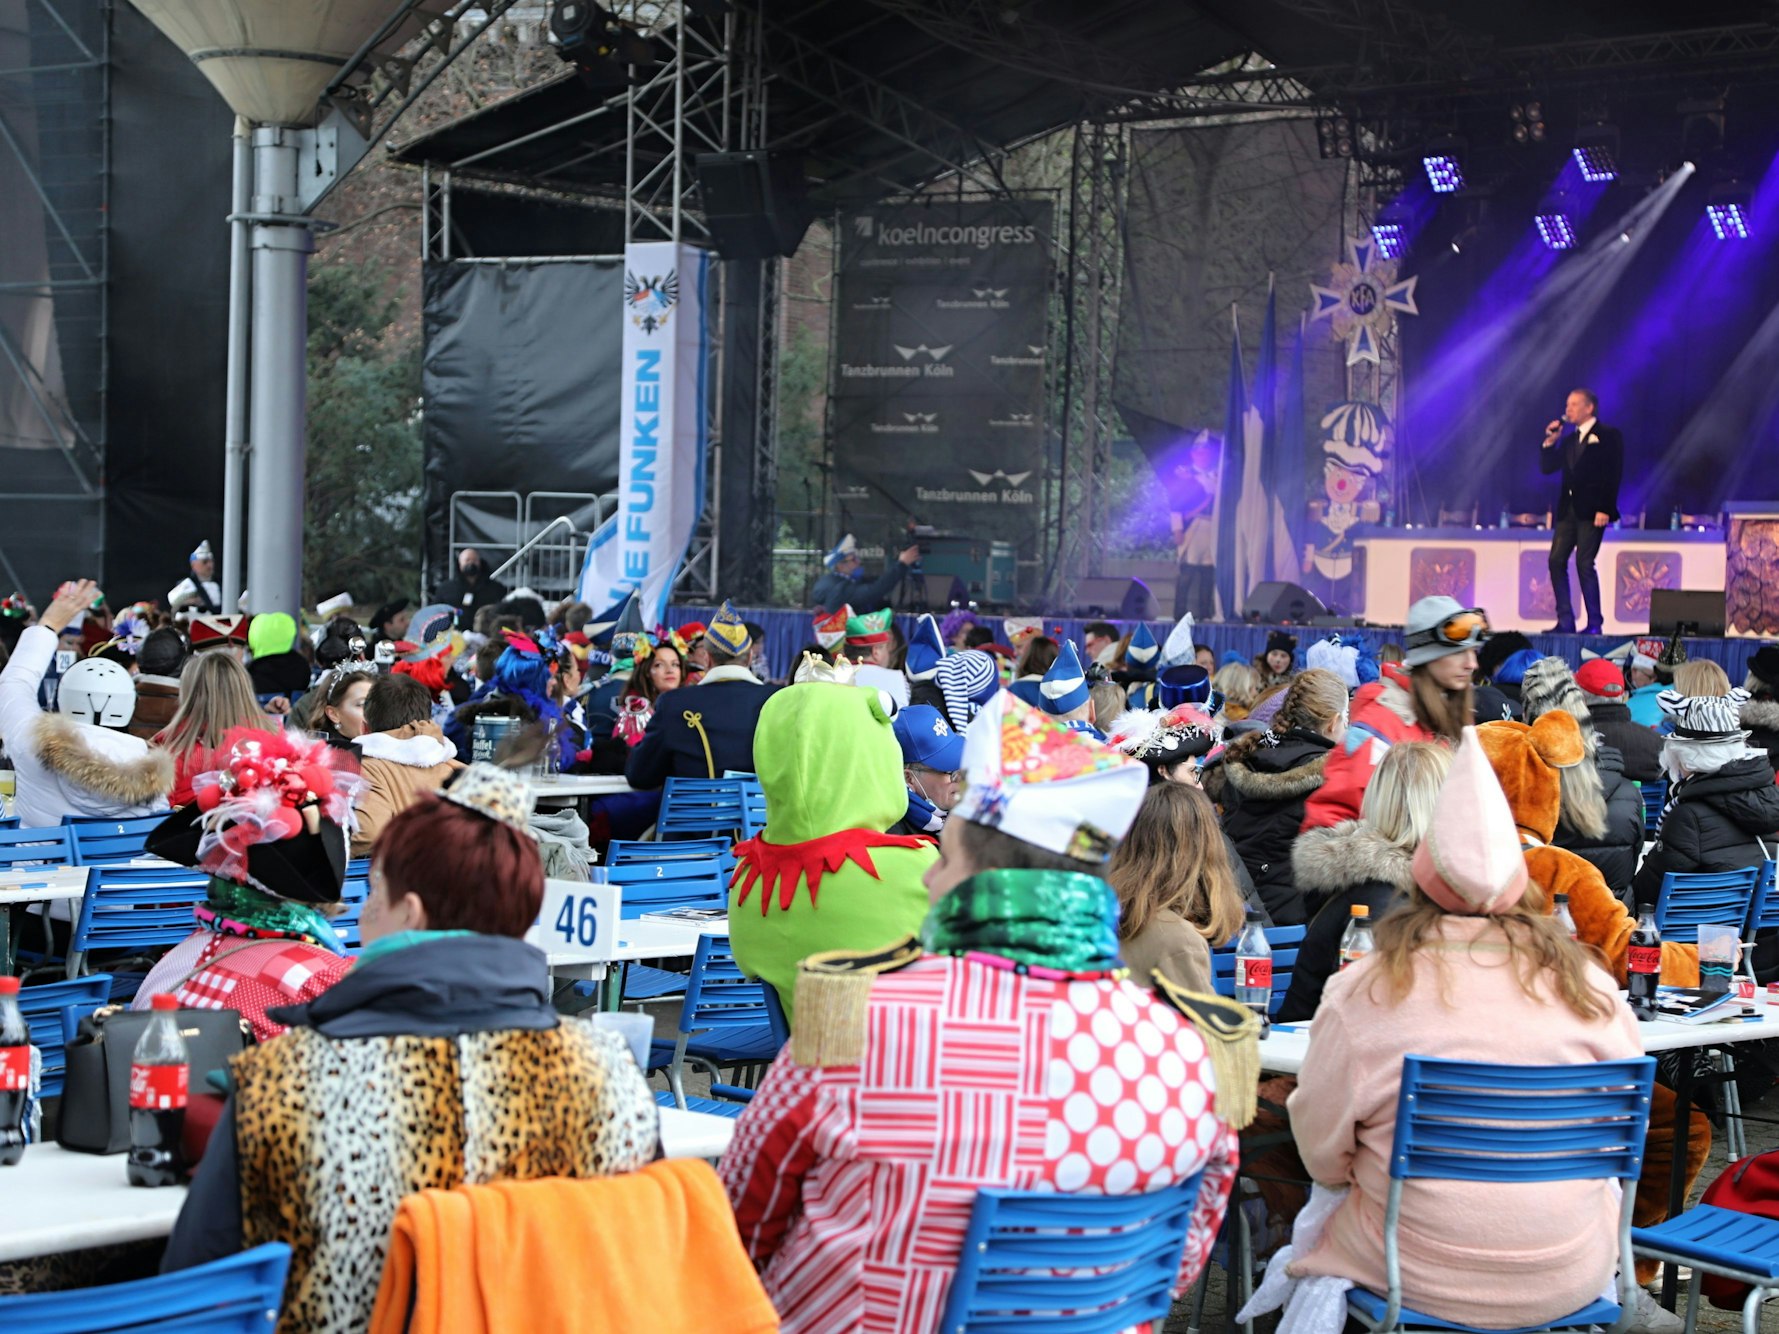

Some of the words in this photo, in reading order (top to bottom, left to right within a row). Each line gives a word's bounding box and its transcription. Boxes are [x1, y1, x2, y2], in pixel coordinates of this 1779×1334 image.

[878, 221, 1035, 249] koelncongress
[841, 363, 920, 377] Tanzbrunnen
[924, 363, 954, 377] Köln
[625, 350, 661, 541] FUNKEN
[915, 487, 998, 503] Tanzbrunnen
[1001, 489, 1033, 504] Köln
[60, 654, 70, 669] 29
[117, 824, 125, 834] 2
[656, 866, 664, 878] 2
[555, 894, 597, 947] 46
